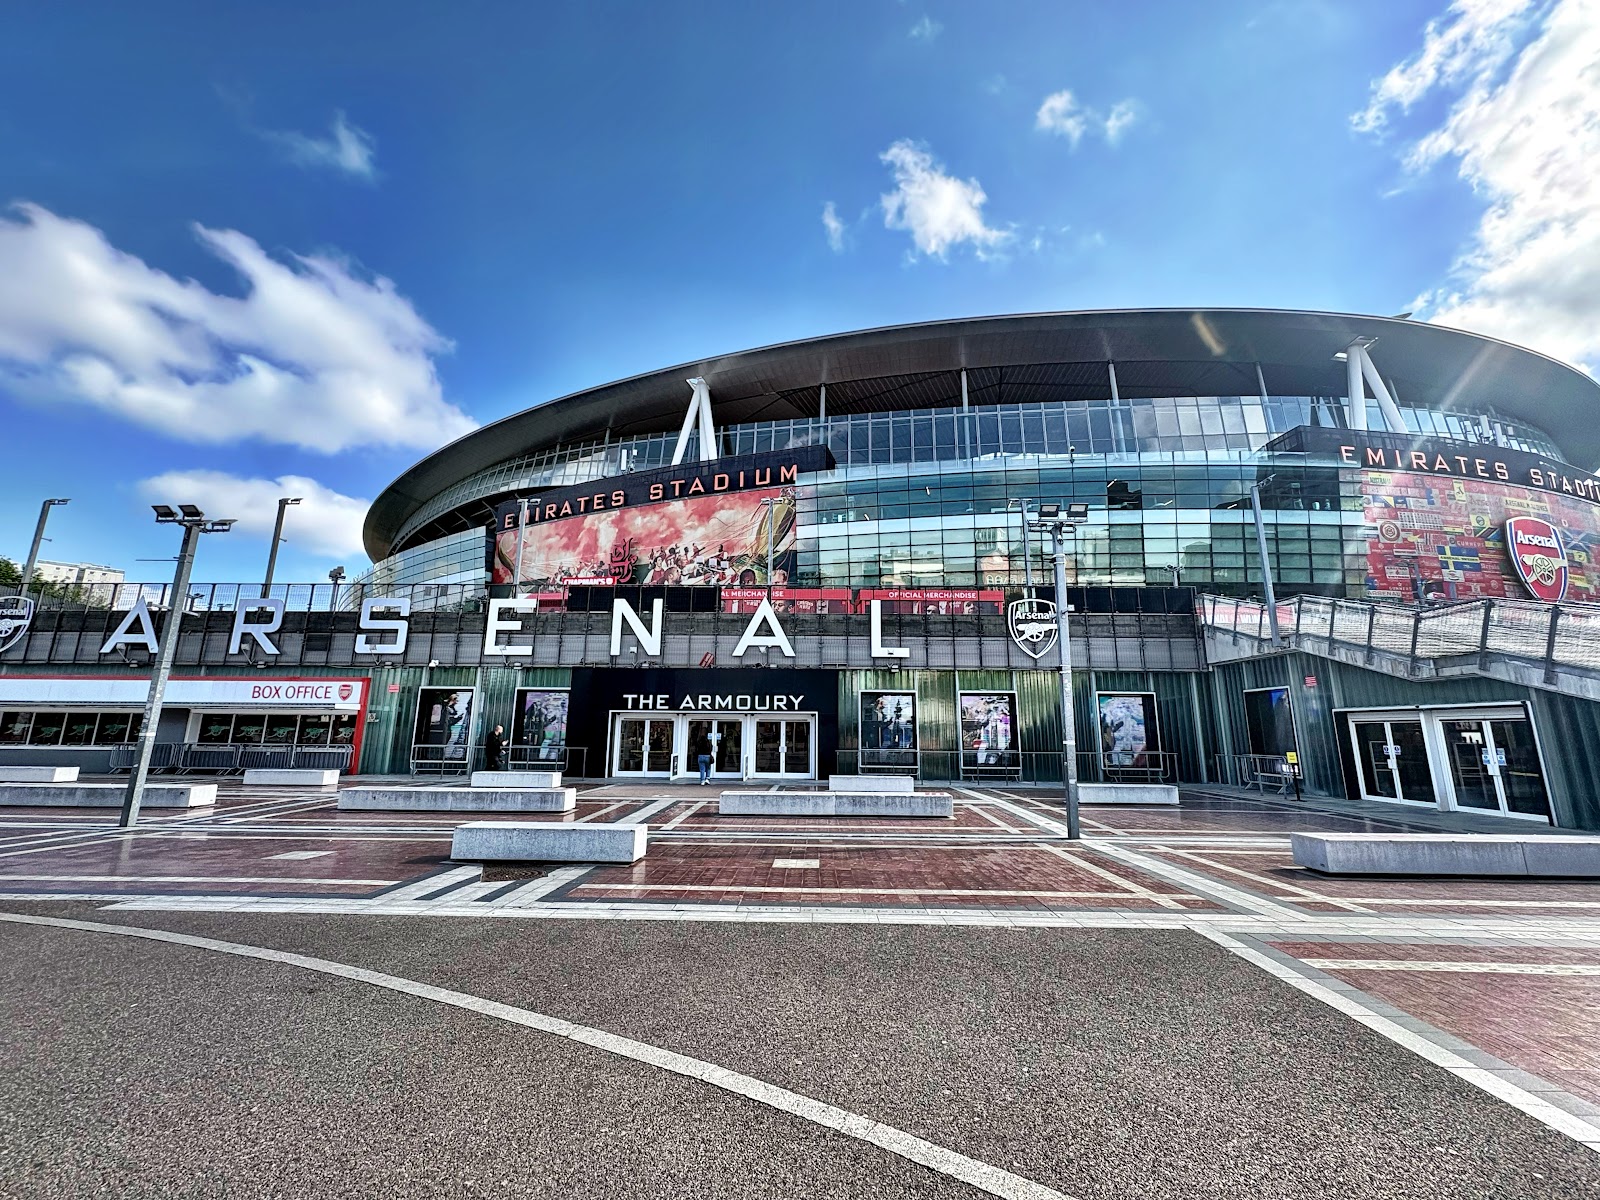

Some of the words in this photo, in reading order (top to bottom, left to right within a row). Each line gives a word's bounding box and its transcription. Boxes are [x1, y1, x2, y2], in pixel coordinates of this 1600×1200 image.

[1340, 445, 1509, 480] EMIRATES
[649, 464, 798, 501] STADIUM
[1516, 529, 1559, 549] Arsenal
[731, 590, 784, 598] MERCHANISE
[0, 607, 27, 616] rsenal
[251, 685, 282, 699] BOX
[285, 685, 333, 699] OFFICE
[623, 694, 670, 709] THE
[679, 694, 805, 710] ARMOURY
